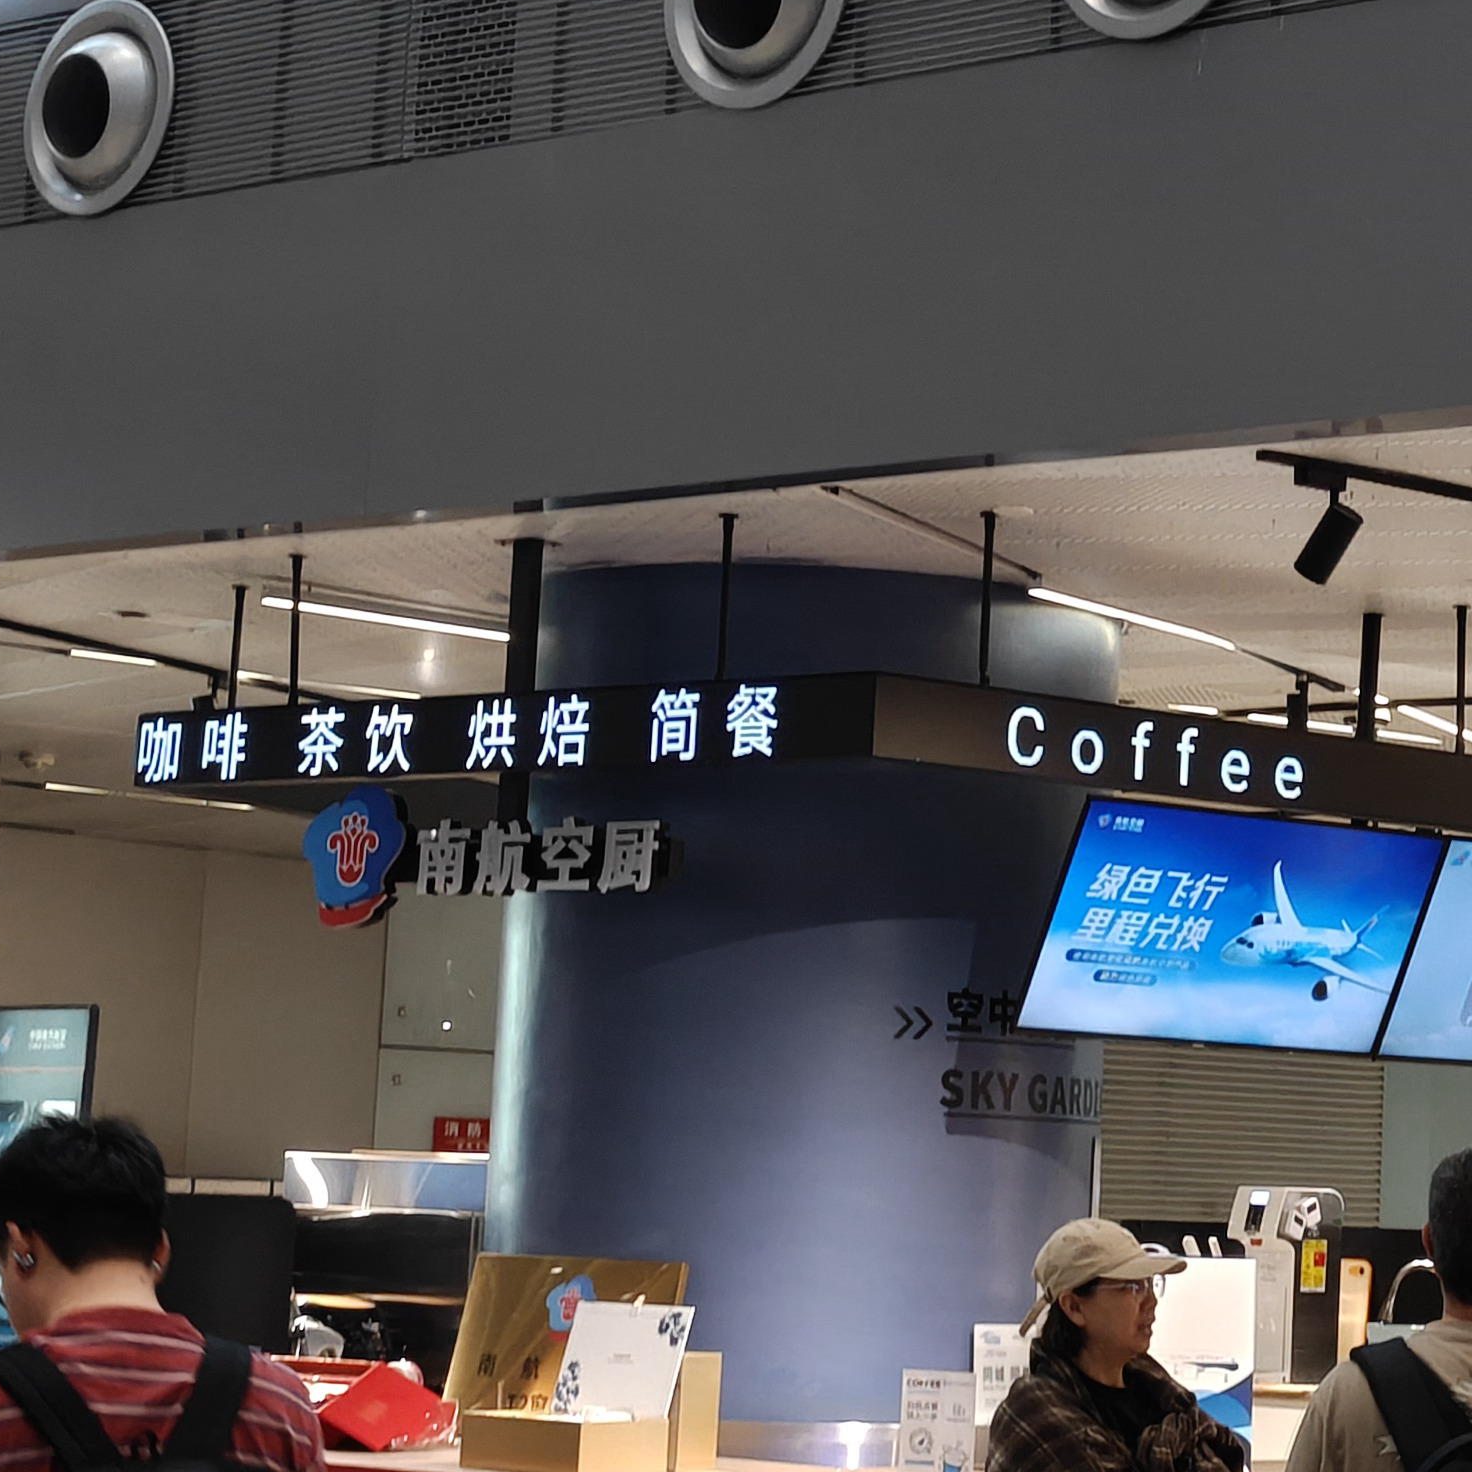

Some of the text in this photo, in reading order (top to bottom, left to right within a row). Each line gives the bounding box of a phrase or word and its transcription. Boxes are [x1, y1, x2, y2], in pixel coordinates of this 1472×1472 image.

[137, 684, 778, 783] 咖啡 茶饮 烘焙 简餐
[1006, 705, 1304, 800] Coffee
[416, 815, 660, 897] 南航空厨
[1086, 863, 1229, 911] 绿色飞行
[1071, 907, 1214, 953] 里程兑换
[940, 1068, 1019, 1112] SKY
